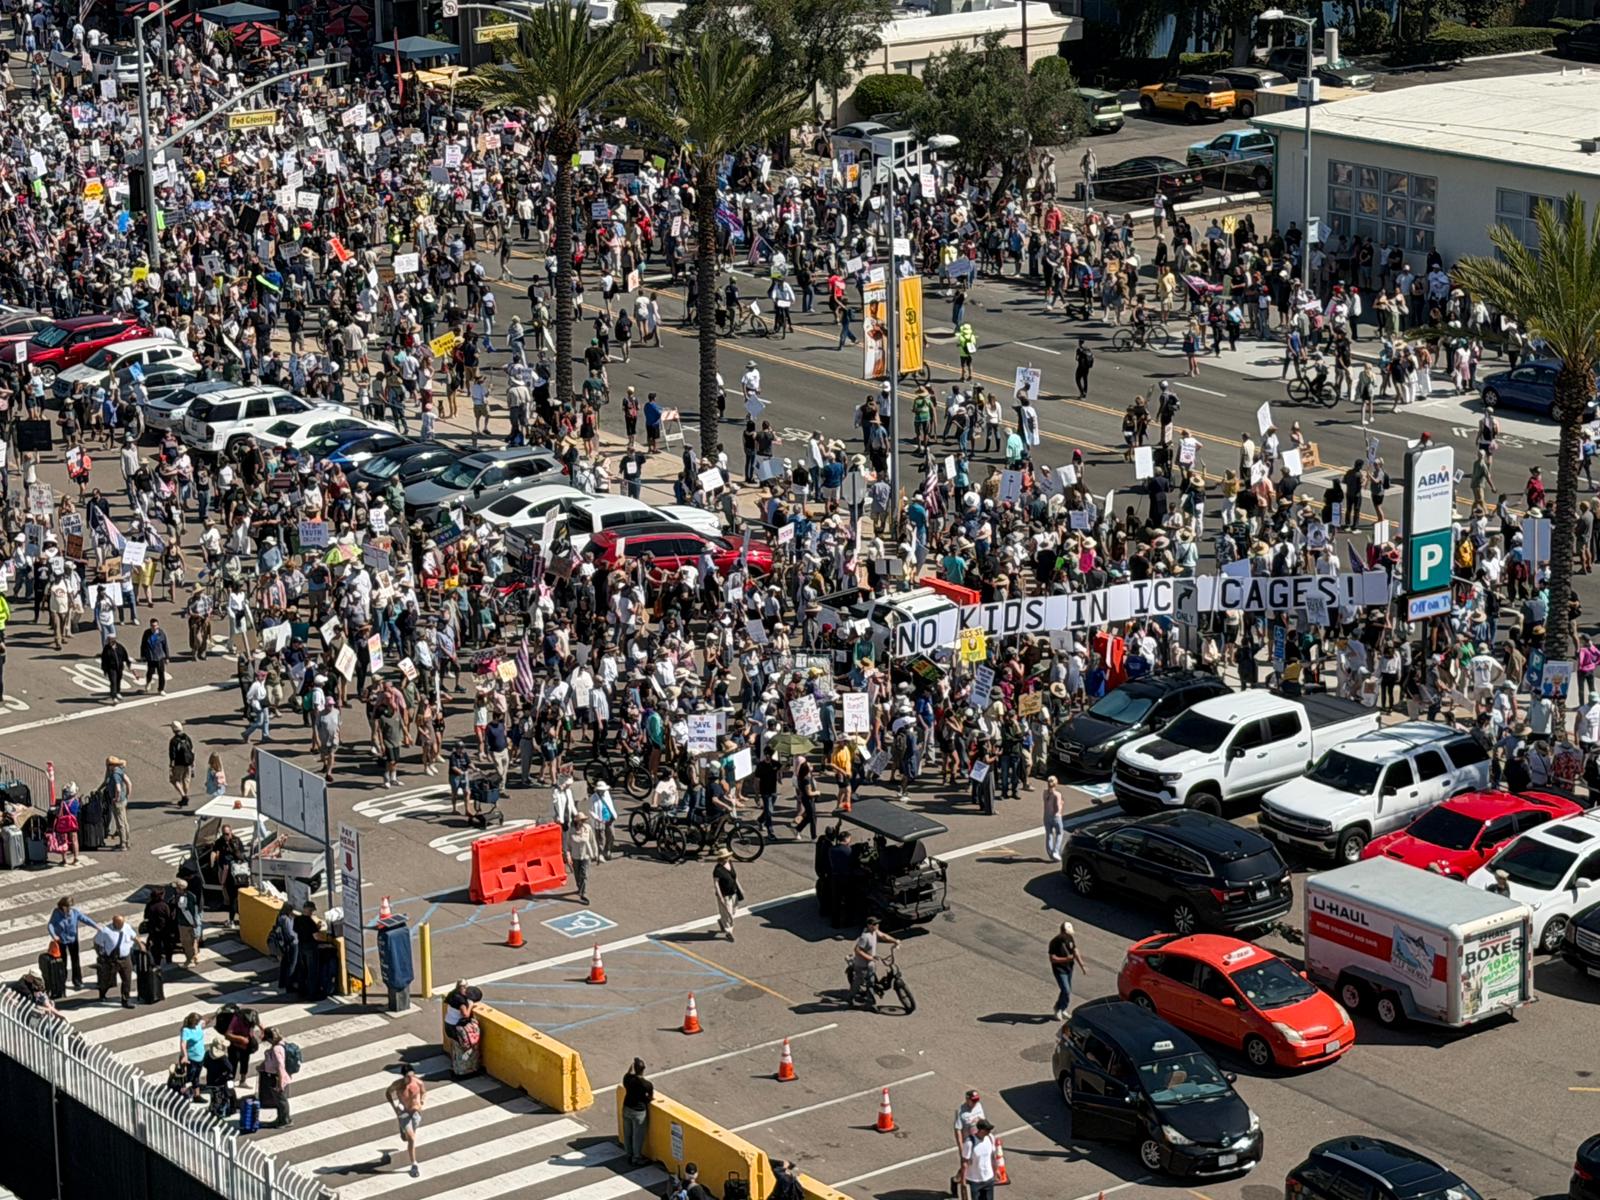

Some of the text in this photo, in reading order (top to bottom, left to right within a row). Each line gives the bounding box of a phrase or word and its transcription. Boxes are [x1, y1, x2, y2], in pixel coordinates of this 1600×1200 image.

[246, 115, 273, 123] Crossing
[1418, 470, 1449, 488] ABM
[1432, 490, 1449, 498] Services
[1420, 544, 1443, 581] P
[1410, 600, 1426, 614] Off
[1428, 600, 1440, 610] on
[898, 576, 1355, 655] NO KIDS IN IC CAGES!
[1176, 610, 1194, 624] ONLY
[341, 826, 353, 839] PAY
[340, 835, 356, 849] HERE
[1313, 896, 1370, 927] U-HAUL
[1465, 937, 1523, 967] BOXES
